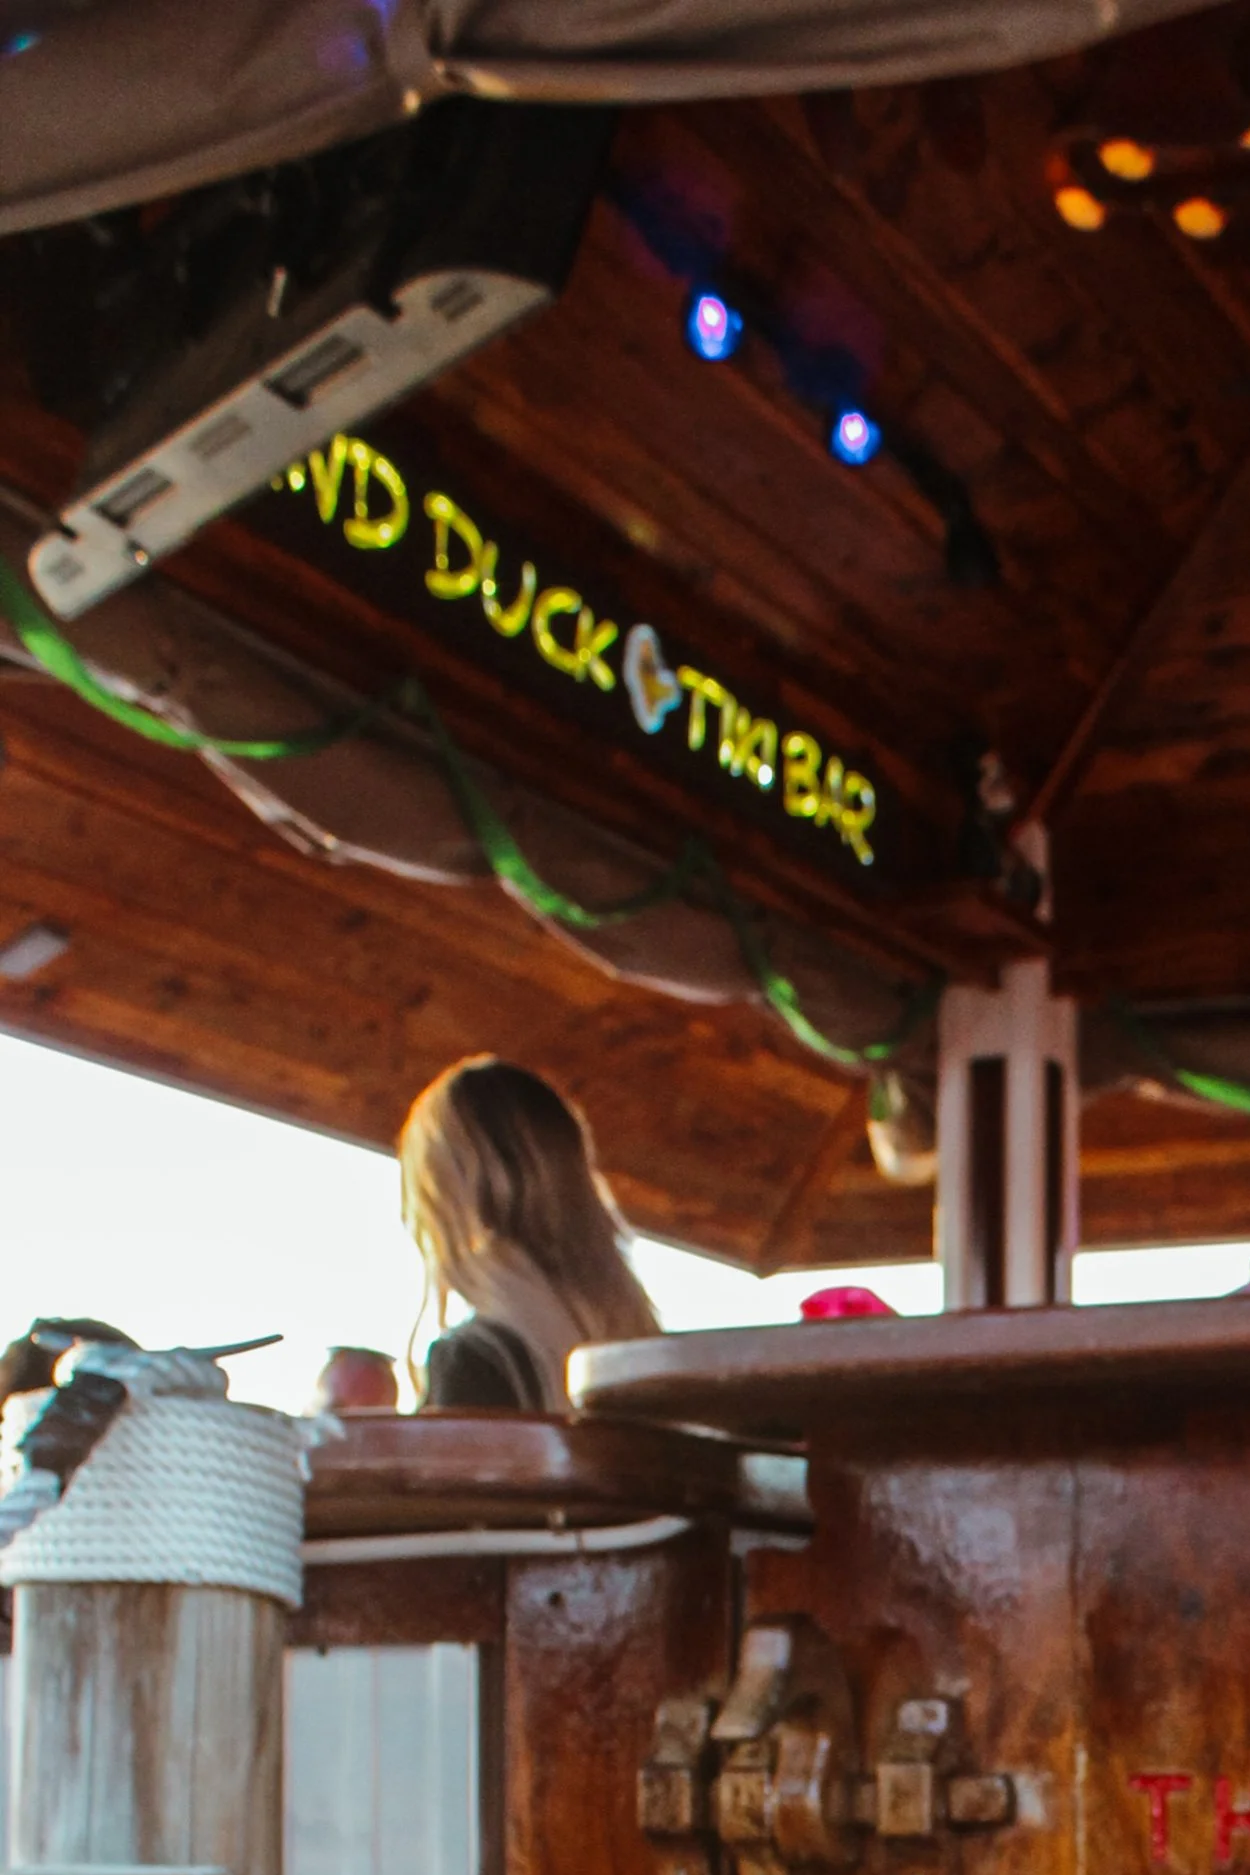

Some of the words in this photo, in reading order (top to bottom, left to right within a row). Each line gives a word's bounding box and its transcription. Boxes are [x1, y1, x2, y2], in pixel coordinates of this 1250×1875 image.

[423, 490, 618, 691] DUCK
[676, 665, 778, 790] TIKI
[781, 730, 877, 867] BAR
